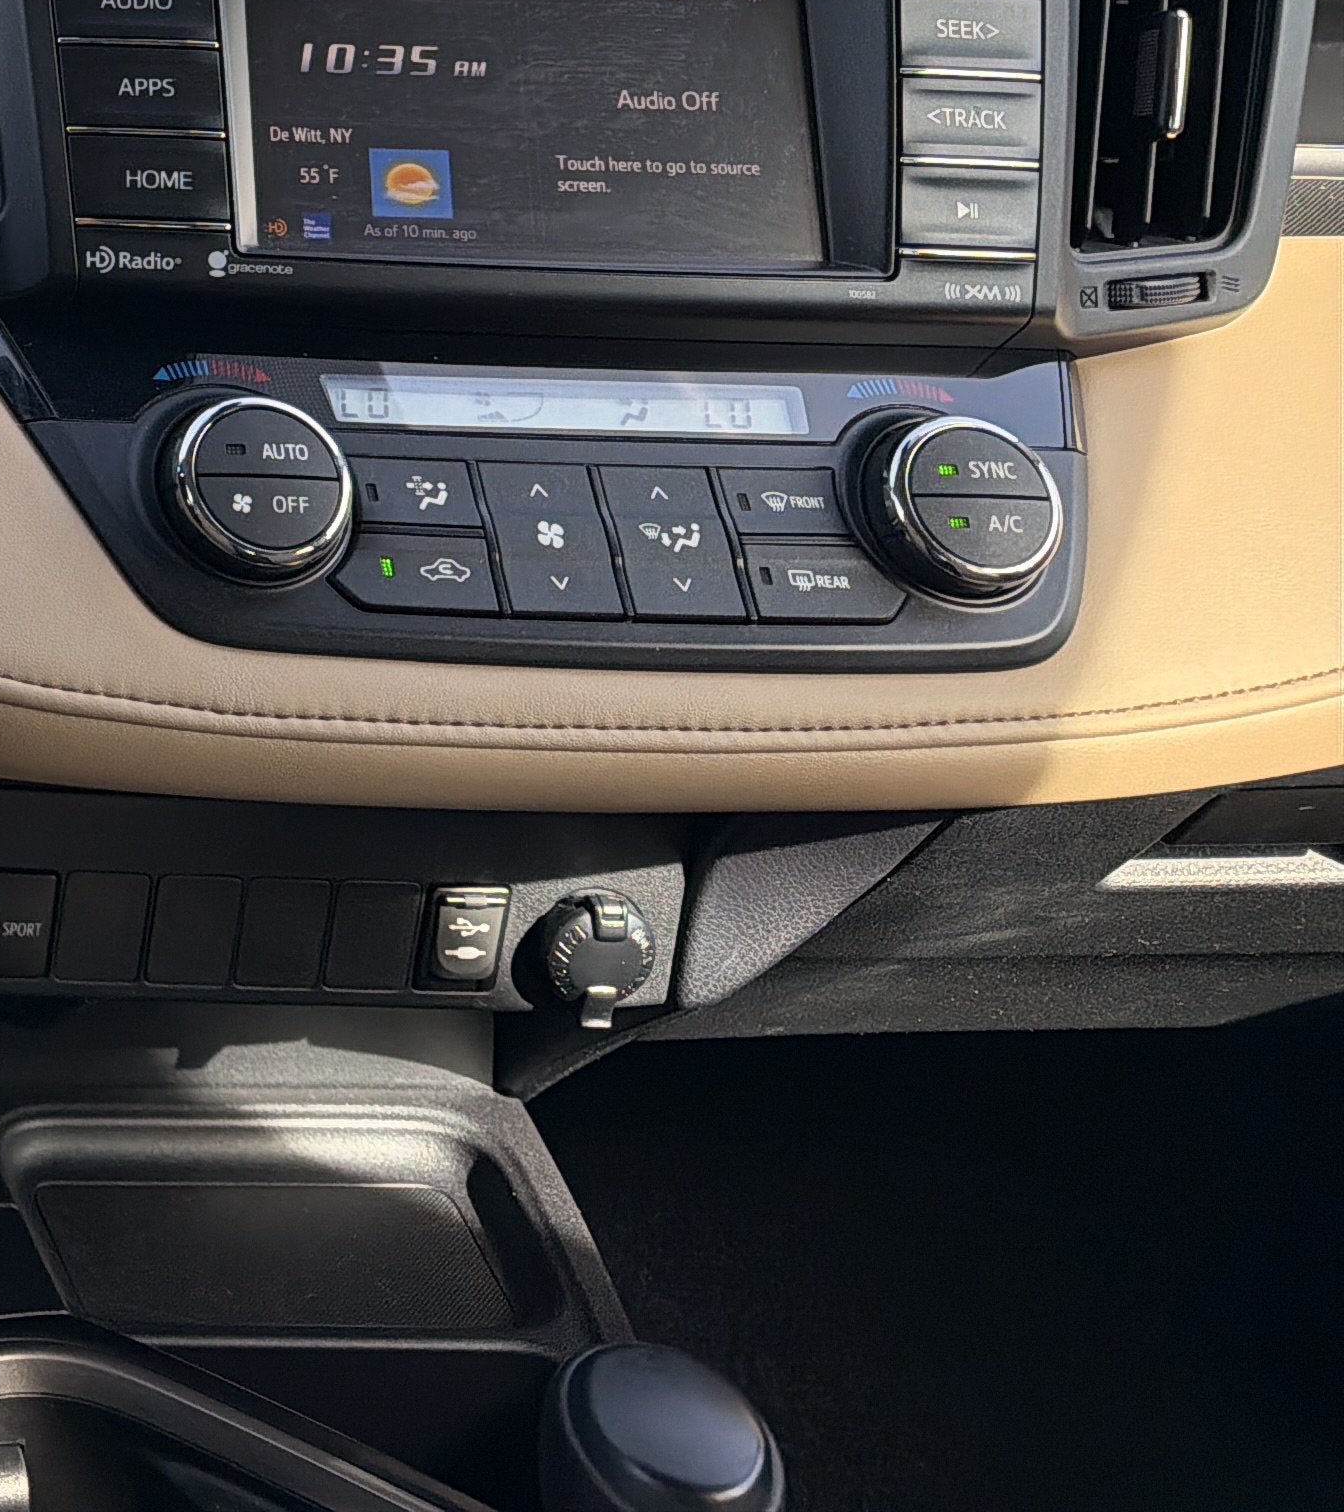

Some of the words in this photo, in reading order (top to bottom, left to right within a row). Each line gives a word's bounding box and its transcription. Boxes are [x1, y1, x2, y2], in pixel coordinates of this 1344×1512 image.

[300, 43, 439, 77] 10:35
[454, 60, 487, 77] AM
[118, 78, 176, 97] APPS
[617, 91, 677, 112] Audio
[682, 91, 720, 112] Off
[269, 126, 290, 143] De
[329, 127, 353, 144] NY
[555, 155, 606, 173] Touch
[608, 156, 643, 174] here
[646, 159, 663, 174] to
[666, 161, 687, 178] go
[690, 160, 707, 175] to
[710, 162, 761, 177] source
[125, 170, 193, 191] HOME
[557, 180, 612, 194] screen.
[364, 225, 381, 239] As
[384, 225, 400, 239] of
[401, 224, 419, 239] 10
[453, 228, 478, 243] ago
[227, 261, 294, 277] gracenote
[262, 443, 309, 462] AUTO
[968, 461, 1018, 481] SYNC
[272, 495, 310, 515] OFF
[789, 494, 825, 510] FRONT
[988, 515, 1024, 534] A/C
[815, 574, 851, 590] REAR
[2, 922, 43, 937] SPORT
